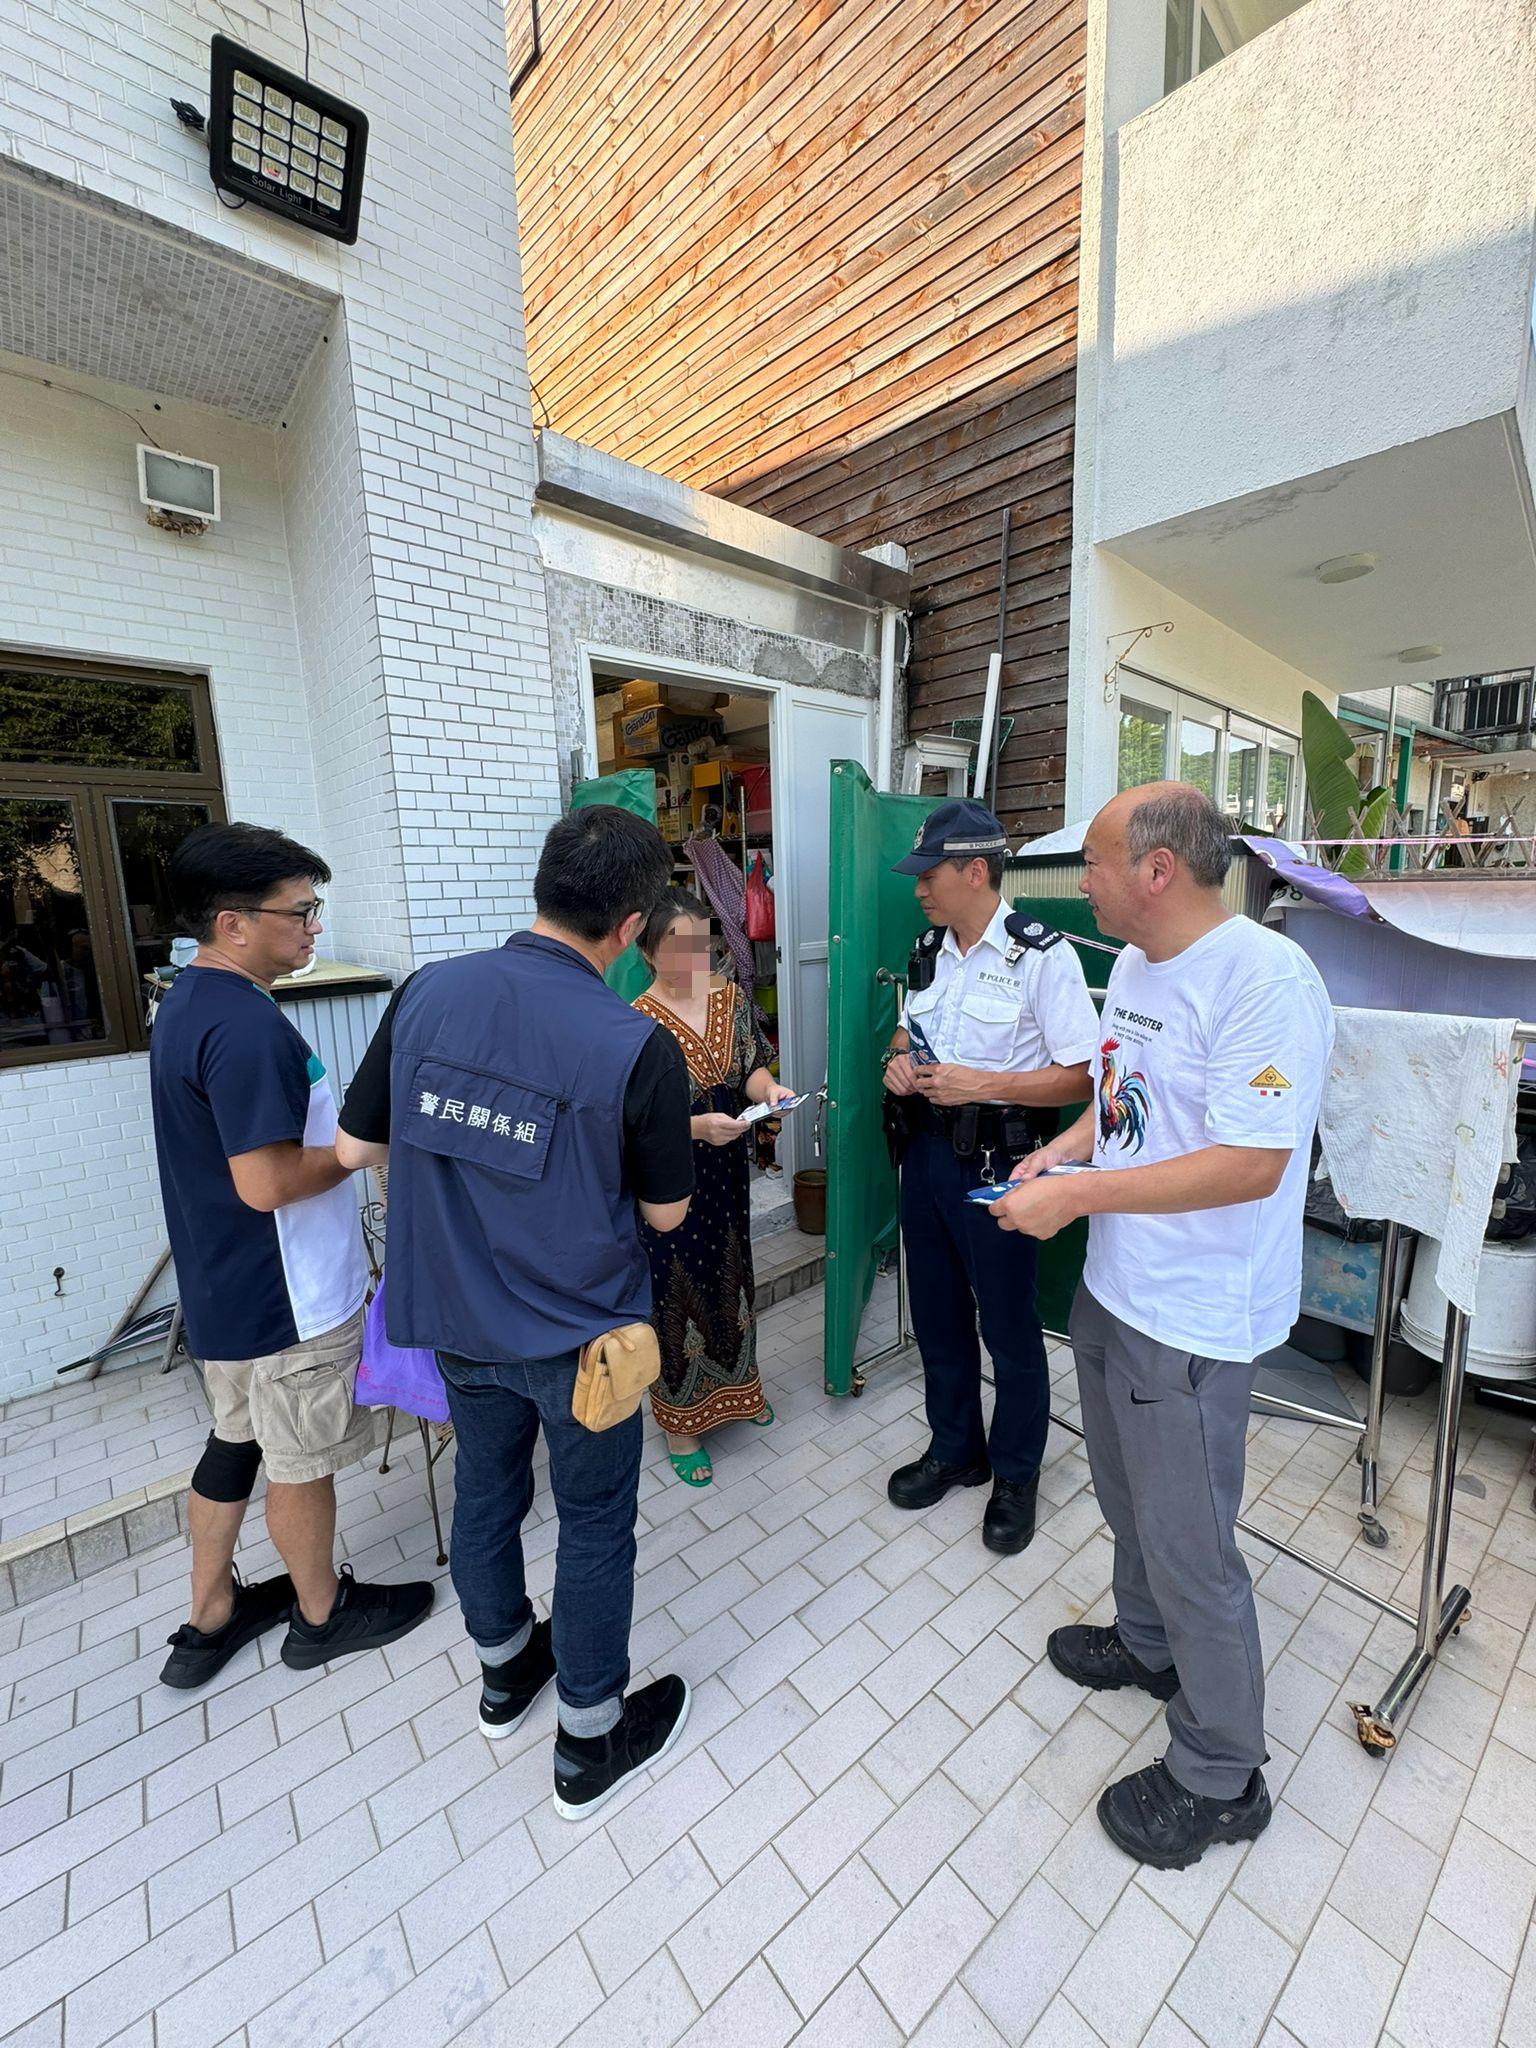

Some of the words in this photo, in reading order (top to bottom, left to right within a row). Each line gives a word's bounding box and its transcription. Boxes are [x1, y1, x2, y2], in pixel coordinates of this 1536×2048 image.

[251, 174, 276, 193] Solar
[279, 187, 302, 205] Light
[987, 973, 1012, 985] POLICE
[1113, 1007, 1128, 1020] THE
[1127, 1011, 1163, 1033] ROOSTER
[419, 1091, 537, 1144] 警民關係組
